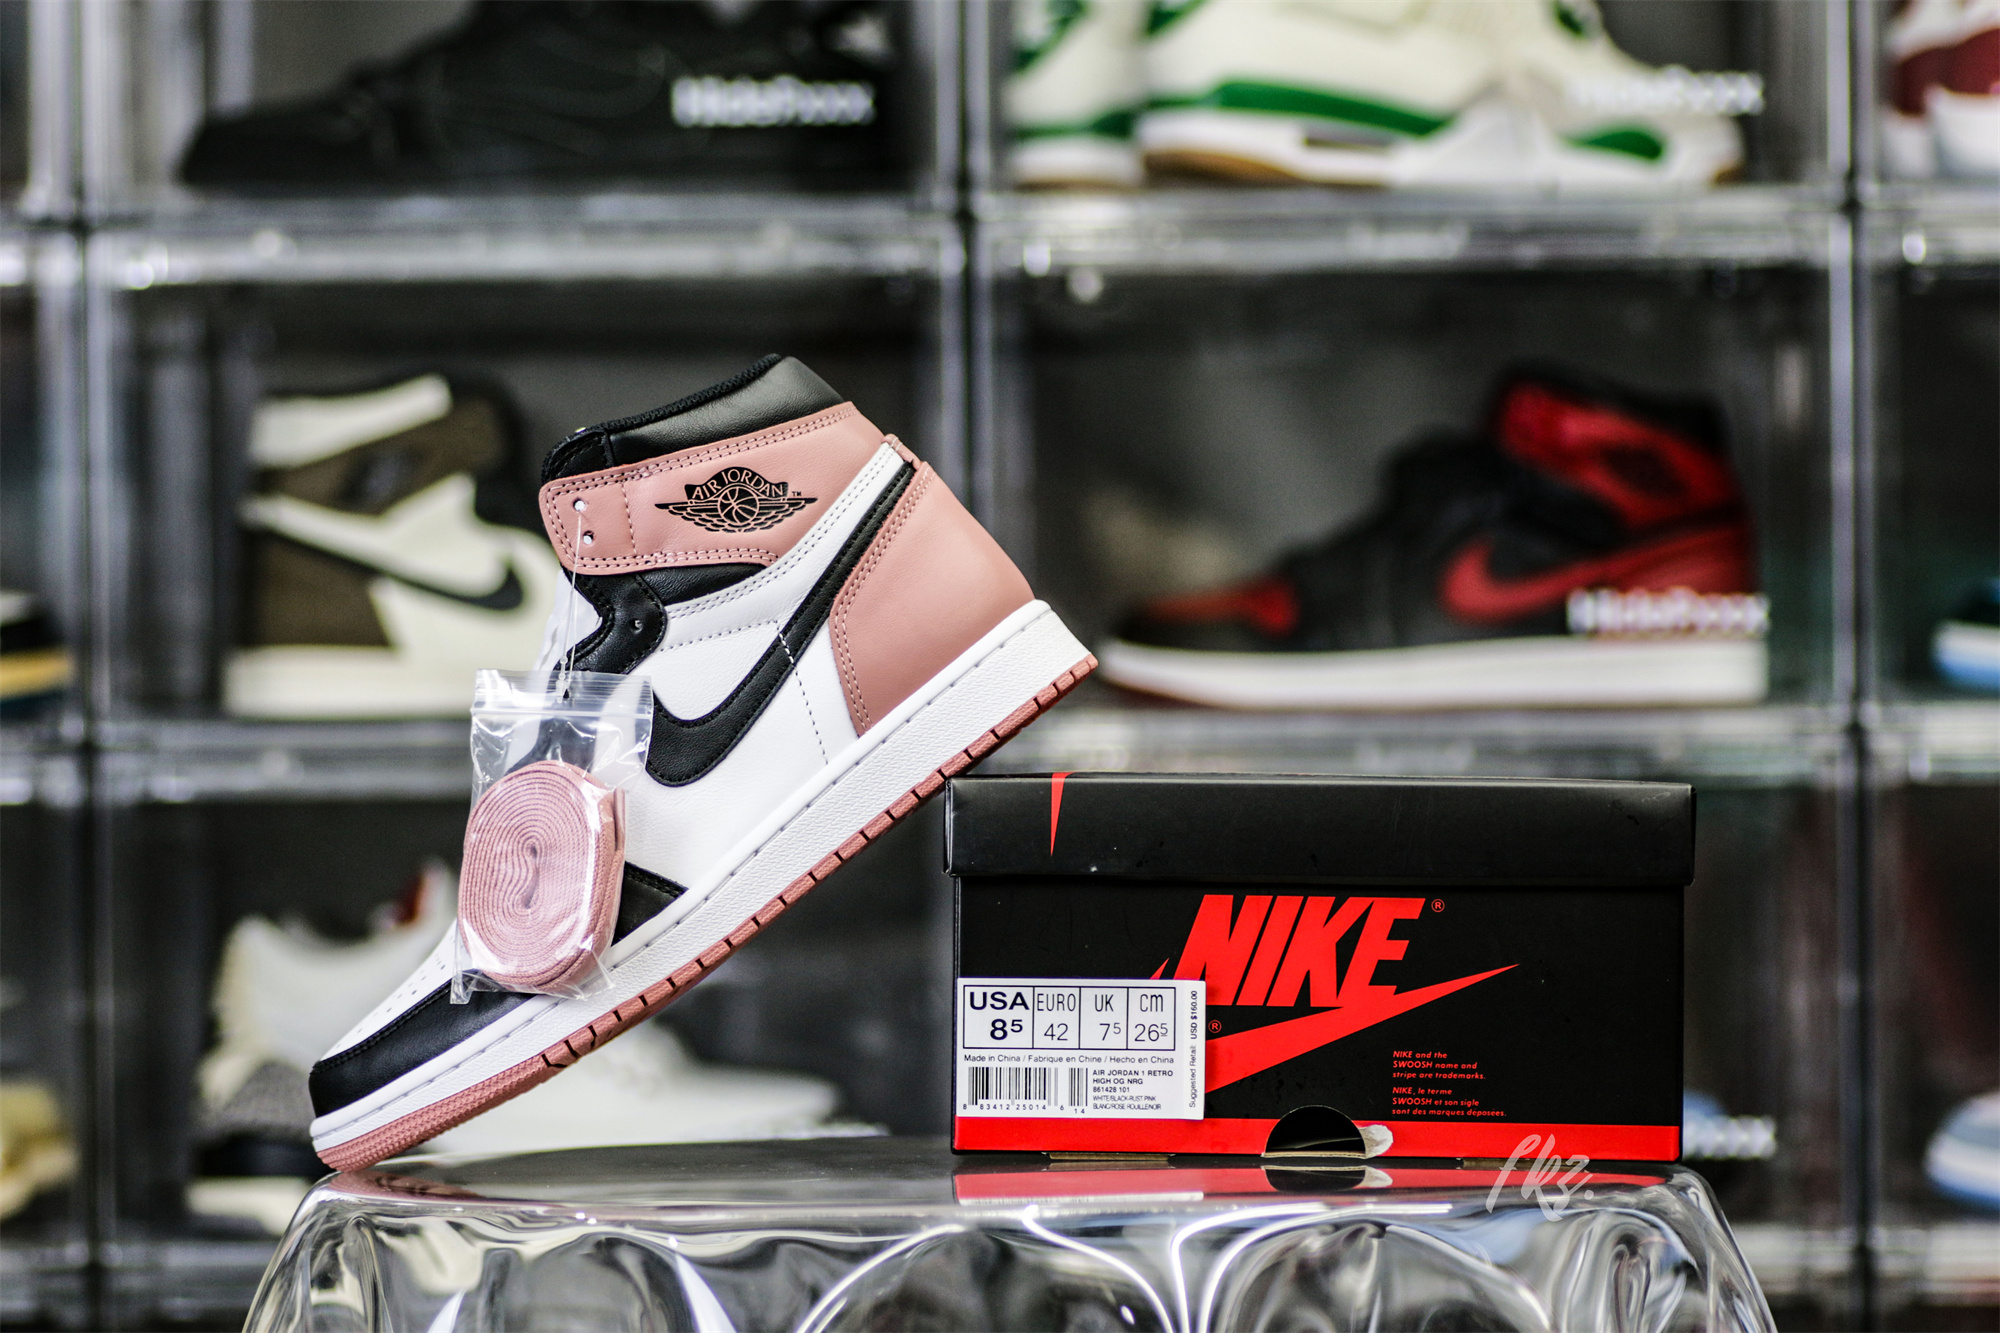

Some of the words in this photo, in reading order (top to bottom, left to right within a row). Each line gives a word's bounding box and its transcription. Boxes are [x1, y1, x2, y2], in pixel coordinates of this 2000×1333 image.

[692, 479, 722, 499] AIR
[721, 468, 784, 497] JORDAN
[1172, 894, 1426, 1007] NIKE
[969, 991, 1030, 1011] USA
[1037, 993, 1077, 1012] EURO
[1094, 994, 1114, 1012] UK
[1190, 990, 1198, 1020] $160.00
[1043, 1023, 1069, 1041] 42
[1190, 1022, 1198, 1040] USD
[988, 1054, 995, 1062] in
[997, 1054, 1021, 1063] China
[1028, 1055, 1063, 1065] Fabrique
[1079, 1055, 1102, 1064] Chine
[1110, 1056, 1136, 1064] Hecho
[1151, 1056, 1175, 1064] China
[1392, 1071, 1417, 1079] stripe
[1189, 1068, 1197, 1108] Suggested
[1392, 1087, 1416, 1095] NIKE,
[1392, 1097, 1432, 1105] SWOOSH
[1460, 1099, 1479, 1107] sigle
[1466, 1108, 1507, 1117] déposées.
